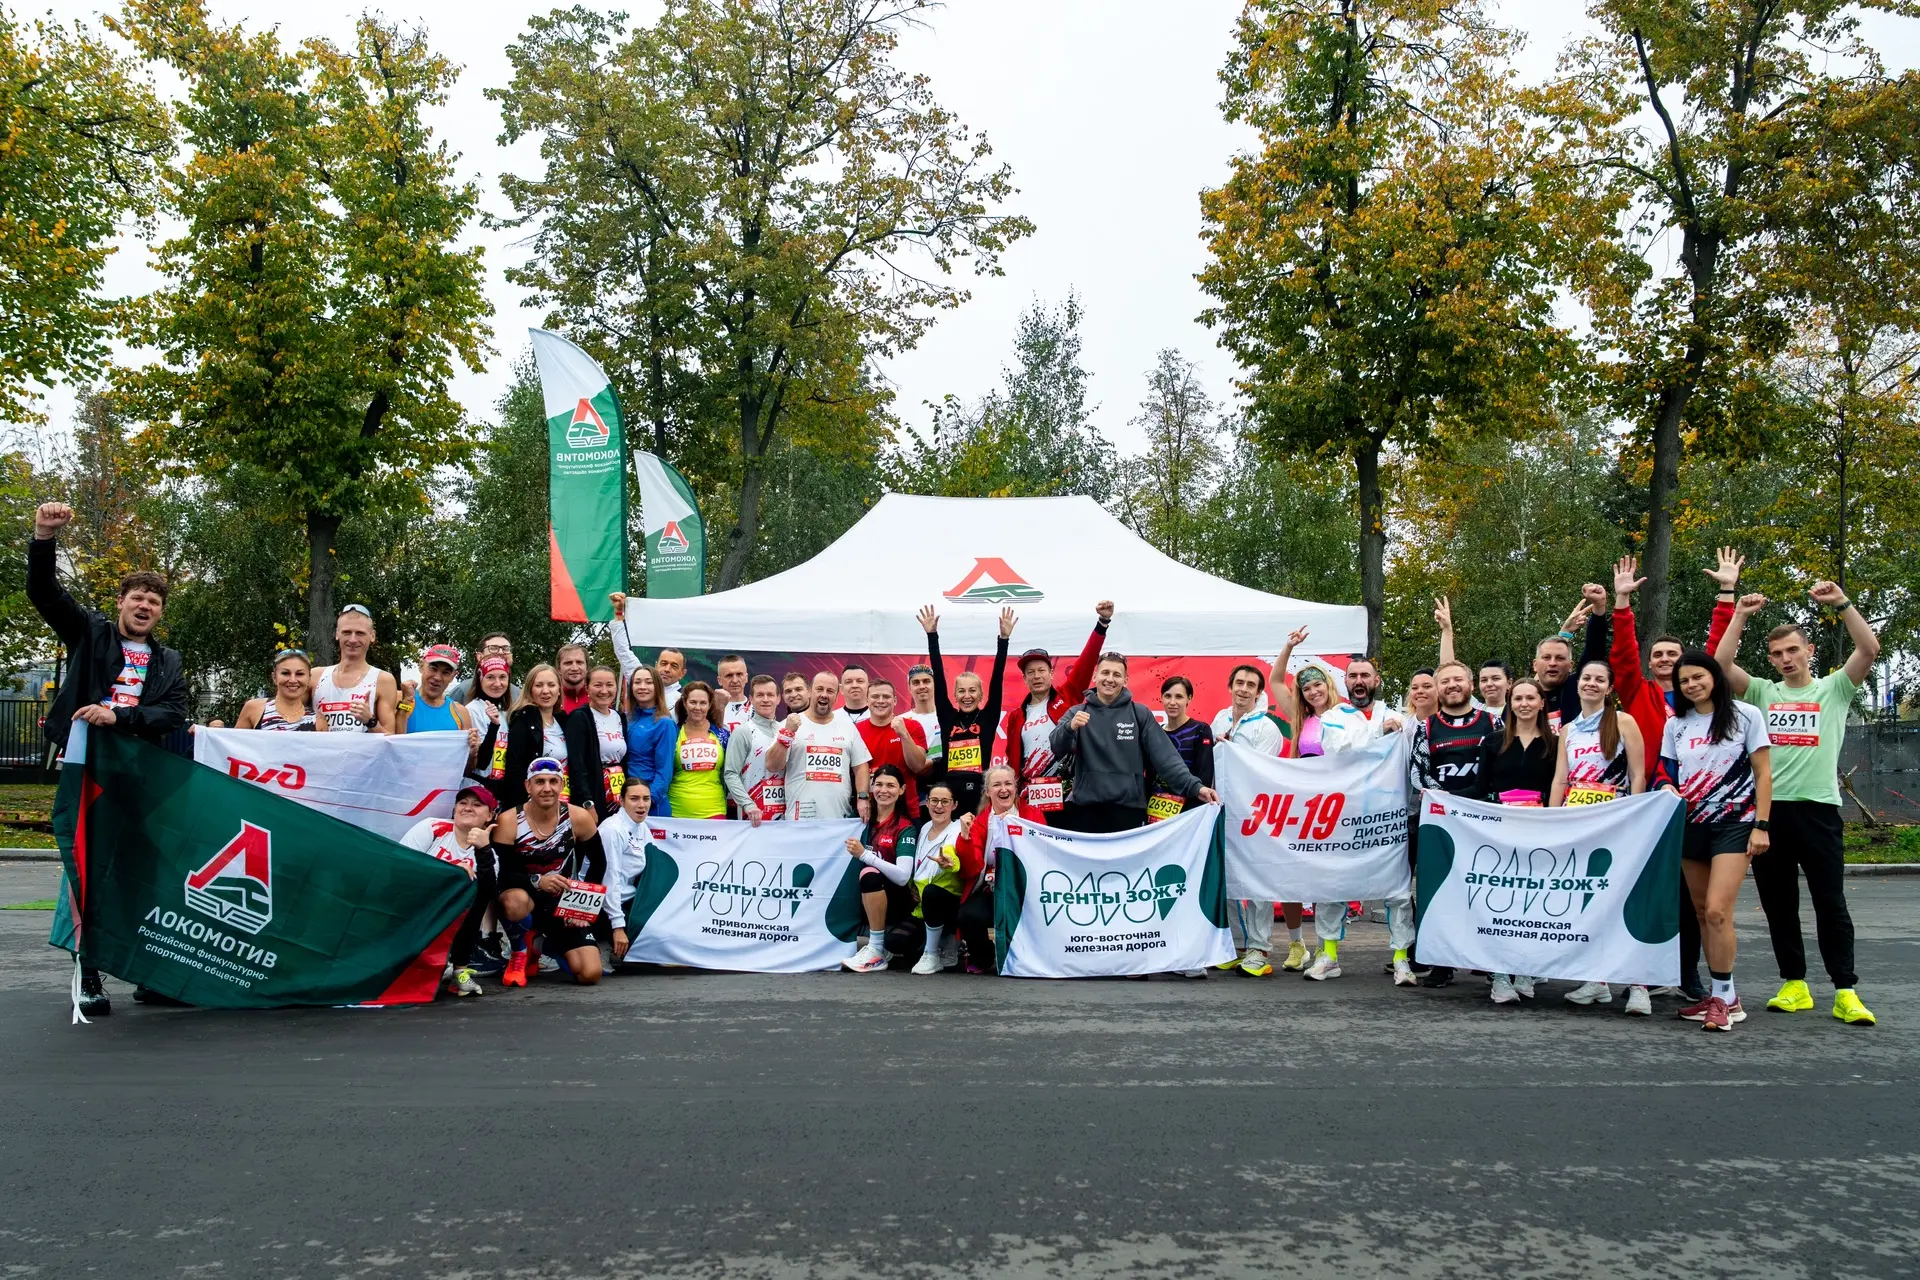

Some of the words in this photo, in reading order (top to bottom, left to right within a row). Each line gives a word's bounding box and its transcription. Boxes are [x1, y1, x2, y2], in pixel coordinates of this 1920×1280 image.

[1769, 713, 1816, 727] 26911
[682, 748, 717, 759] 31256
[808, 755, 842, 767] 26688
[1030, 788, 1062, 800] 28305
[1149, 798, 1181, 815] 26935
[1241, 792, 1346, 840] ЭЧ-19
[1353, 819, 1408, 840] ДИСТАН
[691, 880, 757, 896] агенты
[761, 887, 800, 899] зож
[1465, 872, 1545, 889] агенты
[1549, 878, 1593, 891] зож
[563, 890, 601, 907] 27016
[1039, 890, 1120, 904] агенты
[1126, 886, 1172, 902] зож
[712, 918, 789, 932] приволжская
[1492, 917, 1572, 930] московская
[144, 906, 278, 968] ЛОКОМОТИВ
[701, 926, 757, 939] железная
[759, 933, 799, 942] дорога
[1070, 931, 1161, 943] юго-восточная
[1477, 926, 1538, 939] железная
[1540, 931, 1590, 943] дорога
[138, 925, 196, 953] Российское
[197, 948, 269, 981] физкультурно-
[1064, 943, 1123, 953] железная
[1126, 940, 1167, 952] дорога
[145, 943, 203, 970] спортивное
[204, 966, 251, 989] общество
